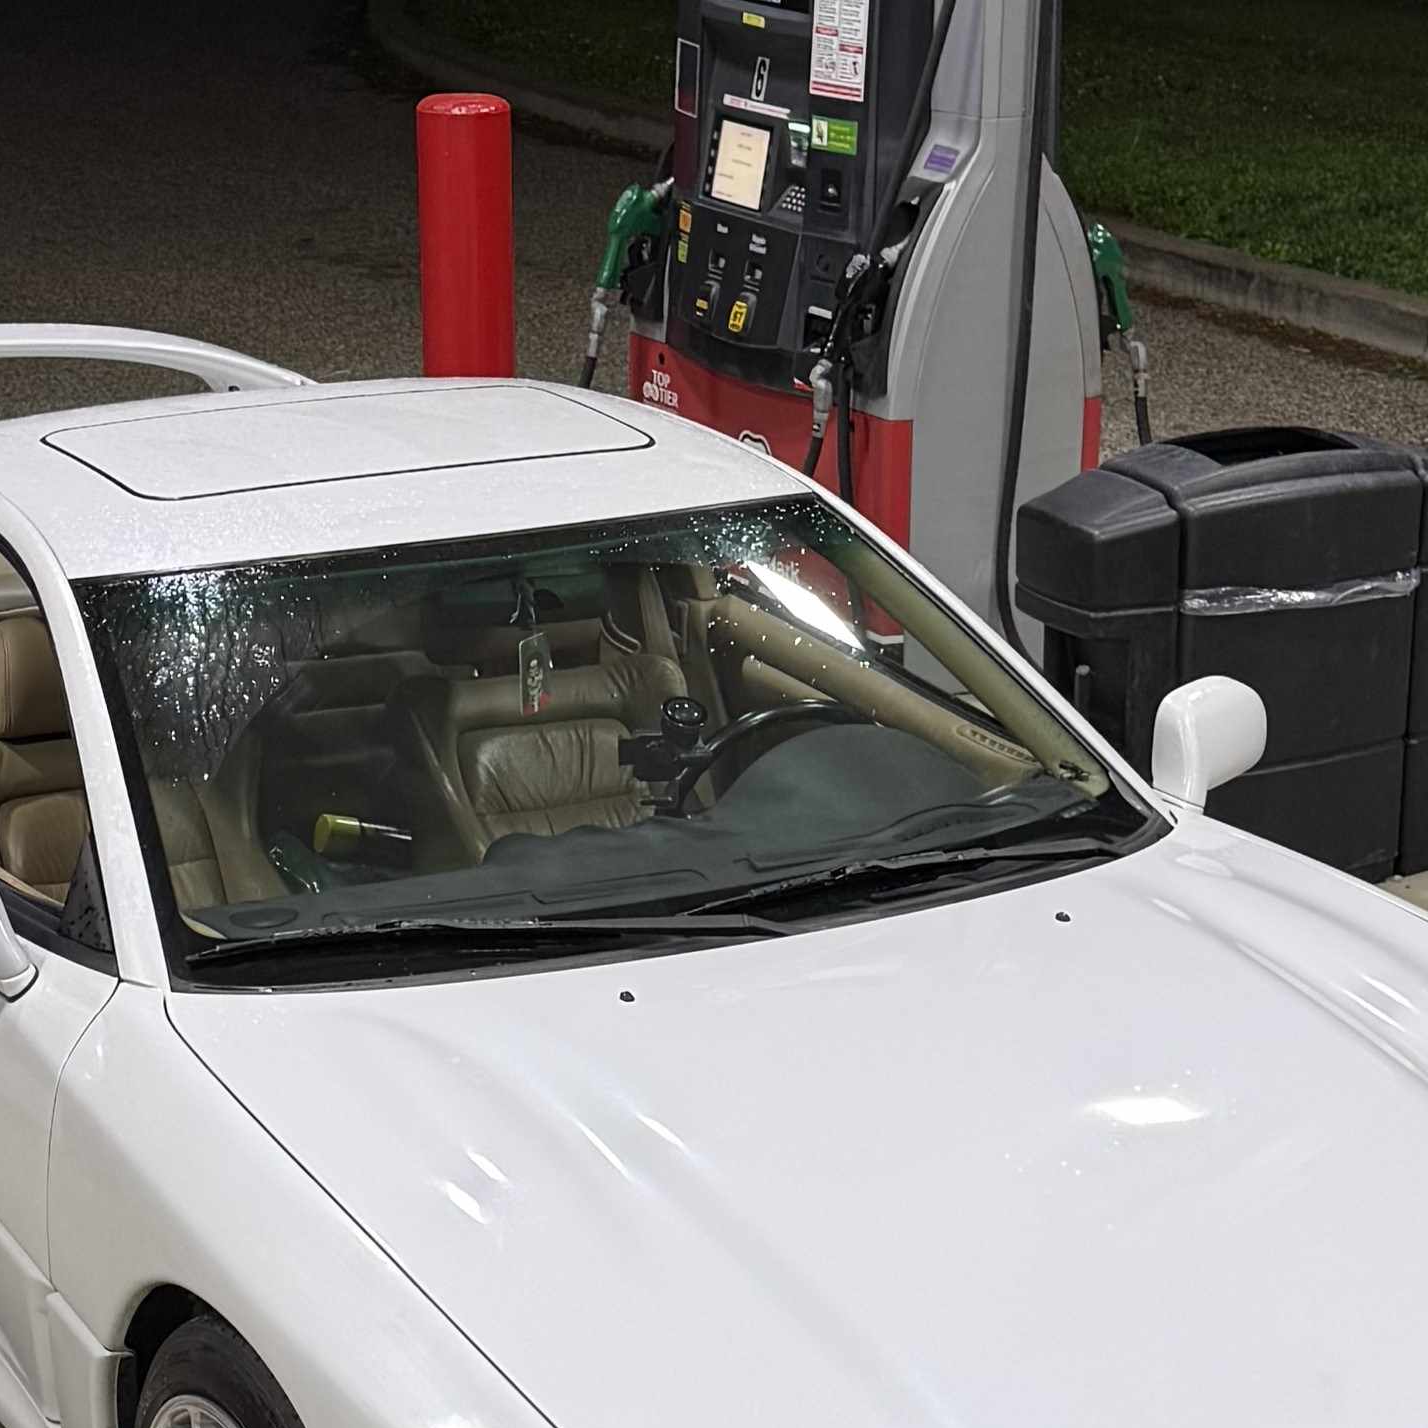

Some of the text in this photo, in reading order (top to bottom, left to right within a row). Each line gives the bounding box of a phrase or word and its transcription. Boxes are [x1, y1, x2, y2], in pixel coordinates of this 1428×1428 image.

[755, 58, 767, 98] 6
[651, 368, 671, 389] TOP
[659, 387, 679, 409] TIER
